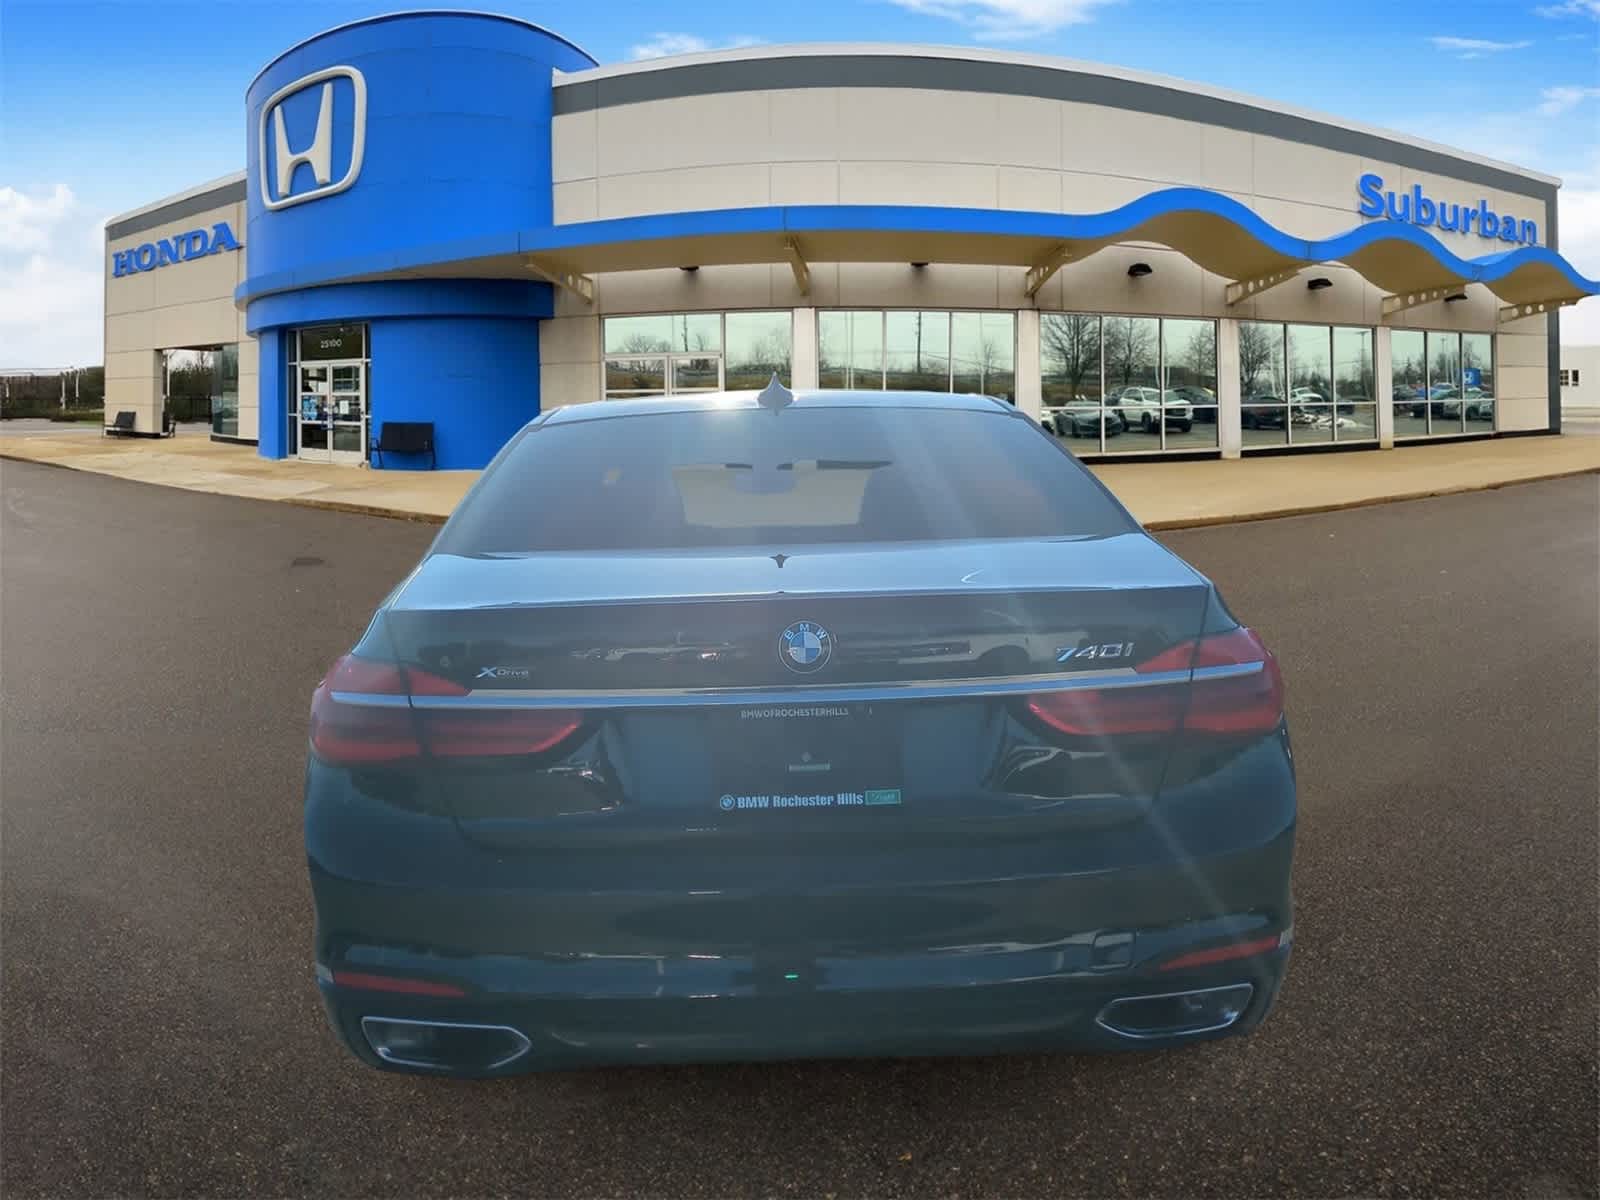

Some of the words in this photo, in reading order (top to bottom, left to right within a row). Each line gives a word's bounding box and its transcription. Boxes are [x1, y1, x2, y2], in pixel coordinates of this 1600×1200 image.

[1359, 173, 1537, 245] Suburban
[112, 221, 241, 278] HONDA
[737, 795, 769, 809] BMW
[773, 793, 835, 808] Rochester
[837, 792, 864, 805] Hills
